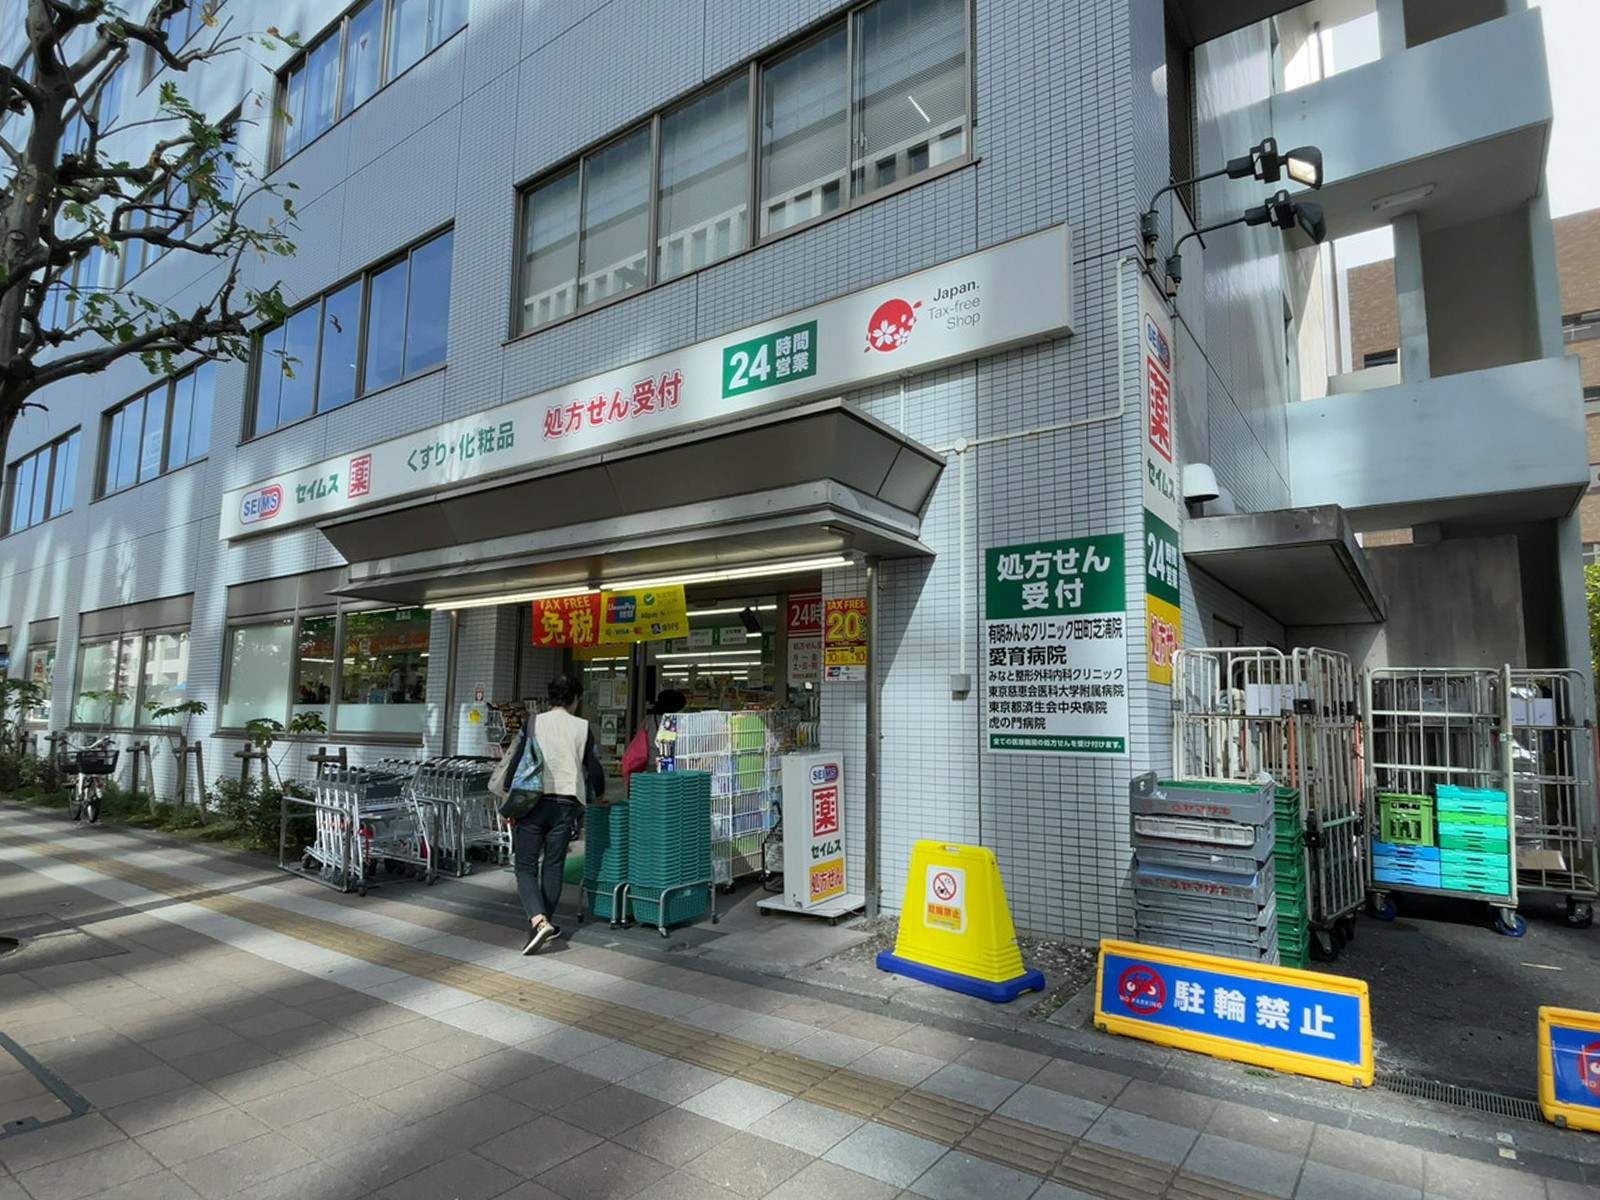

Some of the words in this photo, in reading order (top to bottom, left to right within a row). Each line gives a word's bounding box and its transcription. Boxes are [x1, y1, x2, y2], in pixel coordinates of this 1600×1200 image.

[933, 281, 980, 302] Japan.
[928, 297, 981, 321] Tax-free
[946, 312, 981, 330] Shop
[775, 330, 810, 358] 時間
[729, 344, 771, 391] 24
[775, 352, 810, 379] 営業
[541, 369, 684, 440] 処方せん受付
[1150, 368, 1170, 452] 薬
[407, 420, 514, 472] くすり・化粧品
[296, 473, 339, 503] セイムス
[350, 458, 369, 493] 薬
[1147, 457, 1175, 502] セイムス
[243, 492, 278, 517] SEIMS
[997, 546, 1111, 582] 処方せん
[1147, 532, 1167, 582] 24
[539, 598, 562, 610] TAX
[564, 595, 591, 608] FREE
[827, 600, 842, 610] TAX
[844, 599, 866, 609] FREE
[1021, 578, 1084, 611] 受付
[540, 609, 594, 645] 免税
[988, 616, 1123, 644] 有明みんなクリニック田町芝浦院
[989, 645, 1067, 667] 愛育病院
[988, 668, 1123, 682] みなと整形外科内科クリニック
[988, 684, 1124, 698] 東京慈恵会医科大学附属病院
[988, 701, 1108, 714] 東京都済生会中央病院
[988, 716, 1046, 730] 虎の門病院
[812, 768, 837, 781] SEIMS
[815, 791, 836, 831] 薬
[811, 838, 842, 859] セイムス
[811, 865, 844, 897] 処方せん
[1173, 980, 1337, 1041] 駐輪禁止
